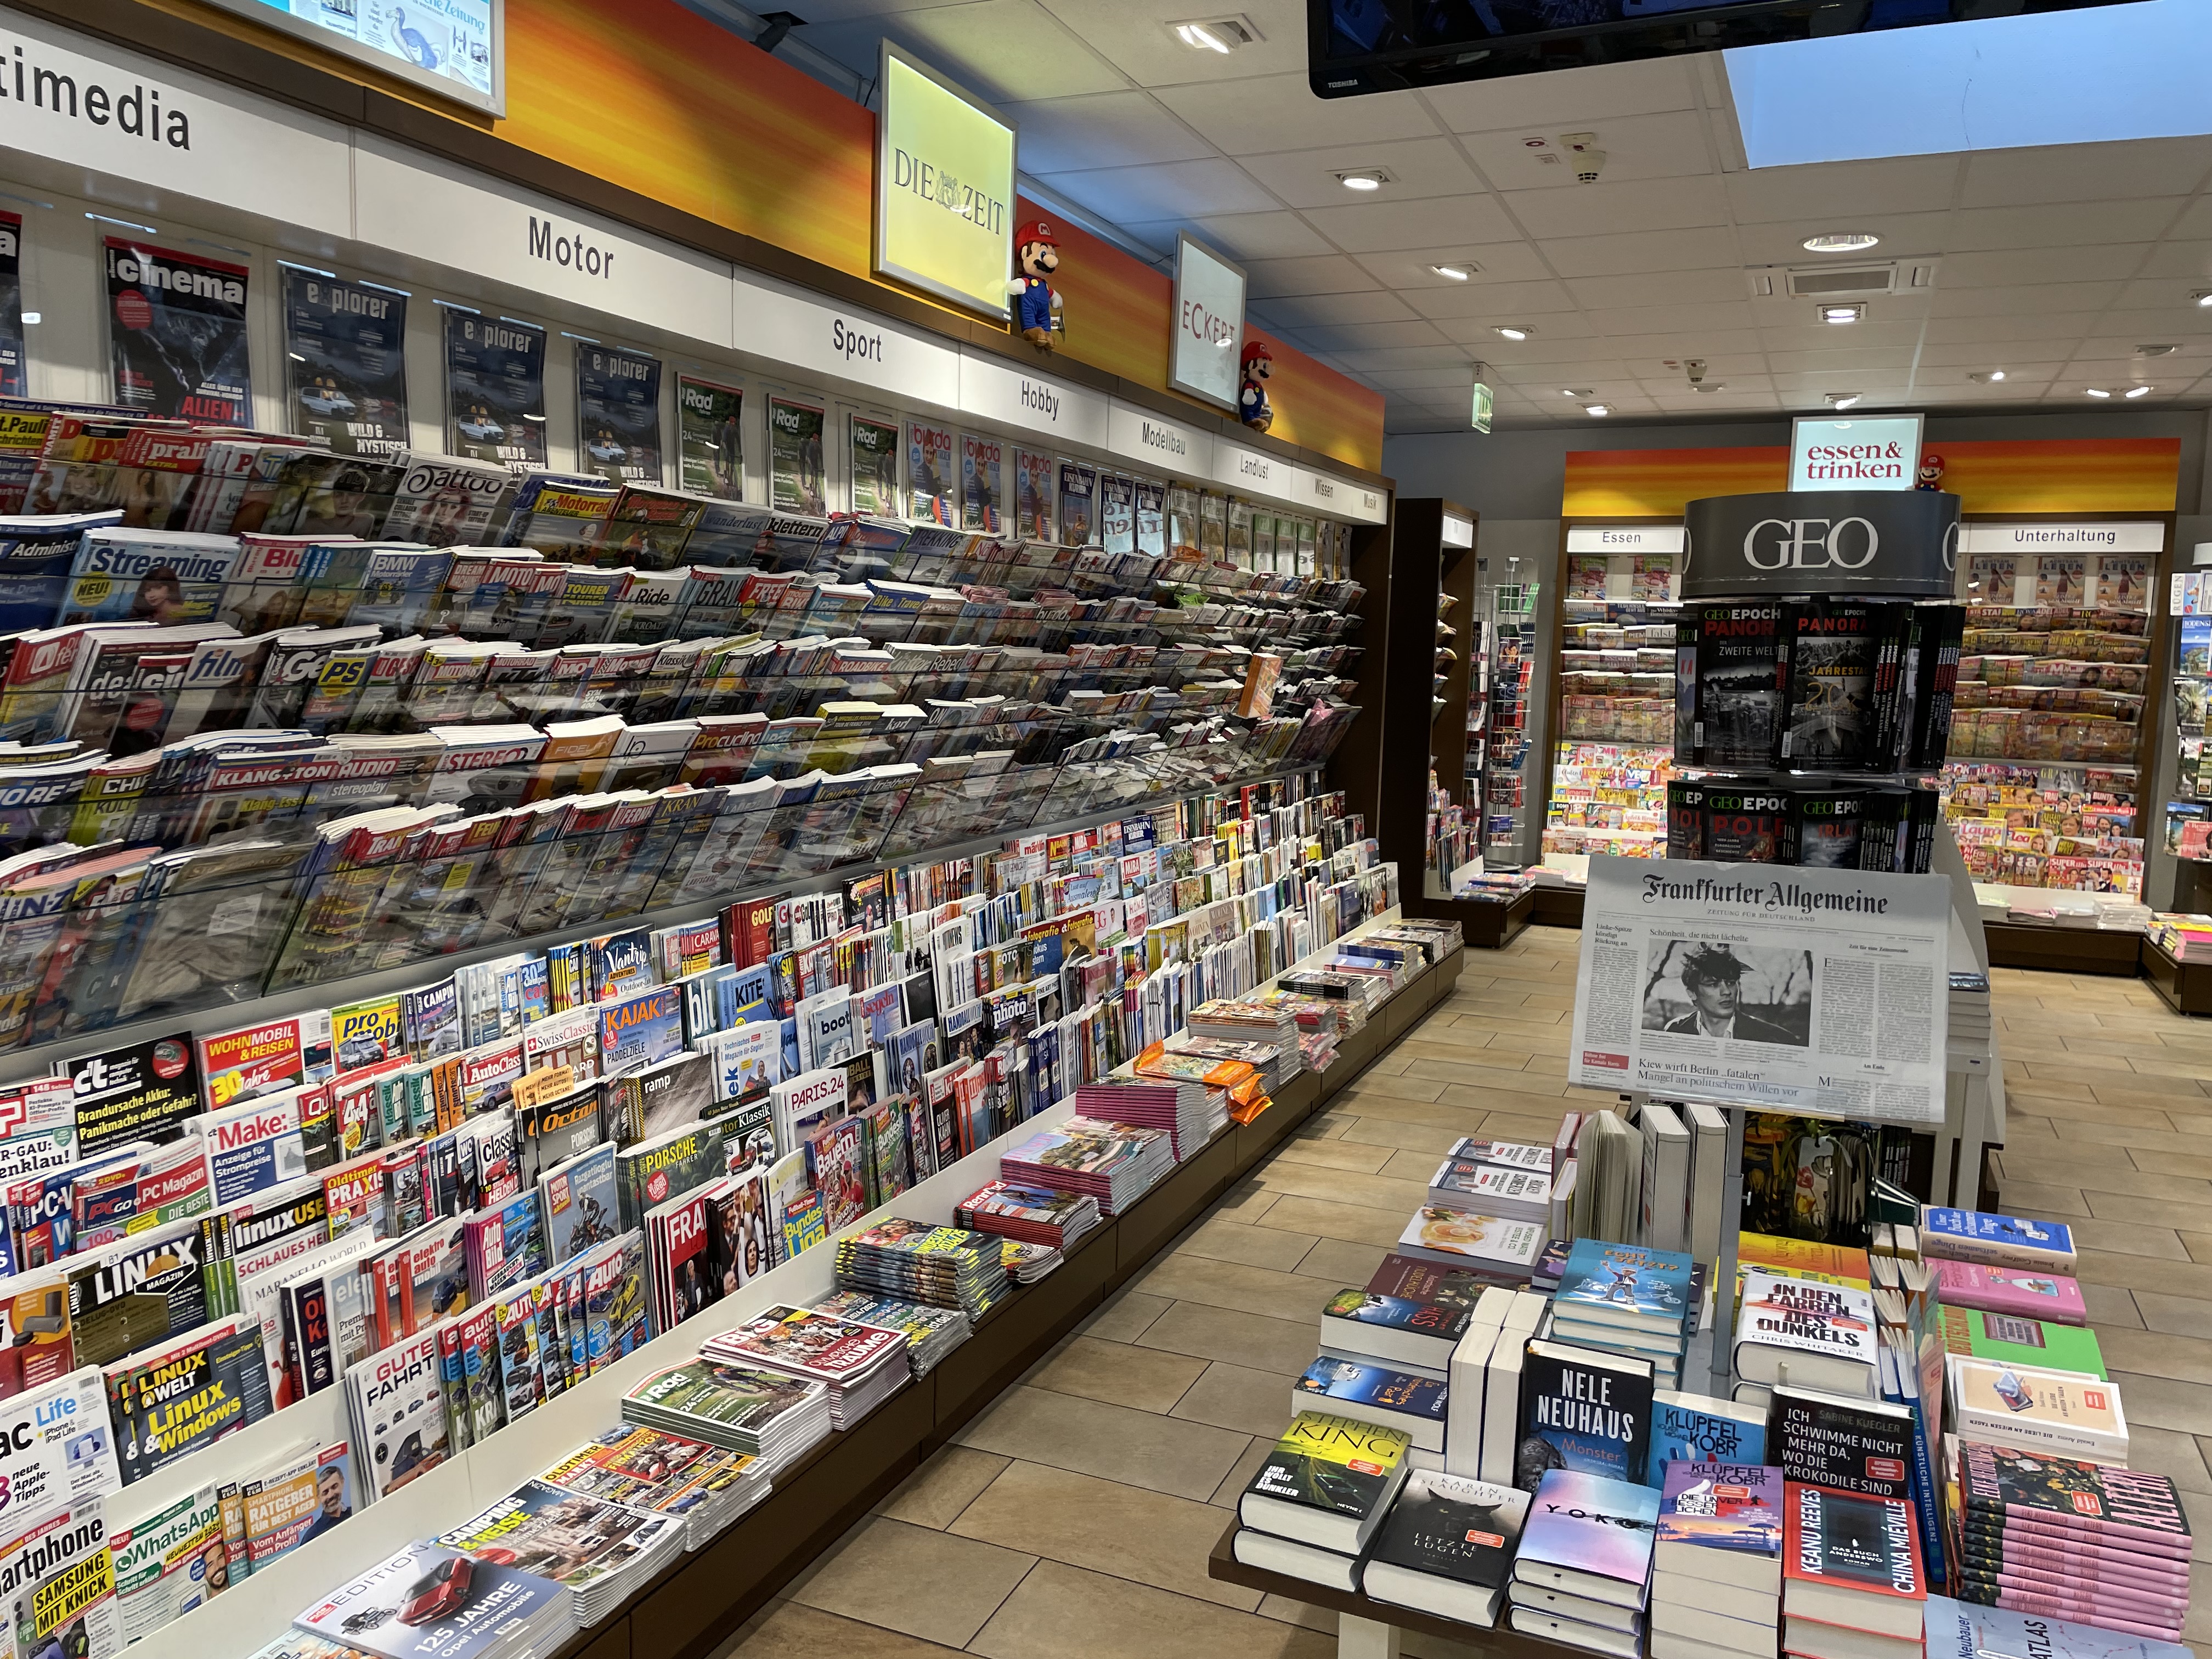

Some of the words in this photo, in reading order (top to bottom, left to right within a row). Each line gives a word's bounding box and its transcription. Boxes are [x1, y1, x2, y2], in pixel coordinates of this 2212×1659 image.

[1328, 79, 1358, 88] TOSHIBA
[894, 148, 935, 202] DIE
[960, 184, 1004, 236] ZEIT
[529, 216, 614, 279] Motor
[116, 258, 246, 306] cinema
[1182, 299, 1236, 353] ECKERT
[833, 319, 882, 362] Sport
[1021, 380, 1060, 421] Hobby
[1142, 421, 1186, 456] Modellbau
[1807, 442, 1882, 461] essen
[1885, 441, 1904, 459] &
[407, 463, 505, 495] Tattoo
[1240, 454, 1268, 481] Landlust
[1807, 461, 1903, 479] trinken
[1315, 478, 1333, 499] Wissen
[557, 493, 608, 513] Motorrad
[1602, 531, 1641, 544] Essen
[1743, 517, 1878, 571] GEO
[2015, 529, 2116, 544] Unterhaltung
[91, 547, 231, 583] Streaming
[375, 555, 420, 572] BMW
[77, 579, 110, 597] NEU!
[566, 583, 609, 595] TOUREN
[635, 587, 670, 607] Ride
[2172, 574, 2184, 612] RÜGEN
[1705, 609, 1730, 620] GEO
[495, 657, 535, 667] MOTORRAD
[1719, 645, 1752, 656] ZWEITE
[839, 660, 887, 673] ROADBIKE
[339, 758, 399, 777] AUDIO
[331, 781, 388, 797] stereoplay
[1709, 795, 1742, 810] GEO
[1804, 801, 1833, 815] GEO
[1074, 833, 1088, 852] MIBA
[1124, 857, 1141, 879] MIBA
[1642, 873, 1764, 906] Frankfurter
[1764, 881, 1889, 915] Allgemeine
[1066, 914, 1094, 932] Fotografie
[1707, 909, 1740, 917] ZEITUNG
[1759, 913, 1816, 922] DEUTSCHLAND
[1027, 926, 1059, 943] Fotografie
[605, 941, 647, 973] Vantrip
[735, 978, 764, 1008] KITE
[343, 1011, 379, 1038] pro
[606, 997, 661, 1032] KAJAK
[821, 1011, 850, 1035] boot
[992, 1001, 1027, 1030] photo
[209, 1025, 295, 1057] WOHNMOBIL
[251, 1038, 294, 1058] REISEN
[607, 1042, 646, 1064] PADDELZIELE
[1639, 1058, 1661, 1069] Kiew
[1690, 1065, 1718, 1075] Berlin
[644, 1073, 672, 1094] ramp
[791, 1073, 845, 1110] PARIS.24
[1638, 1070, 1673, 1083] Mangel
[1690, 1077, 1745, 1091] politischem
[1748, 1082, 1779, 1094] Willen
[77, 1094, 144, 1125] Brandursache
[145, 1087, 171, 1107] Akku:
[80, 1110, 138, 1141] Panikmache
[139, 1105, 161, 1122] oder
[162, 1093, 198, 1116] Gefahr?
[219, 1112, 291, 1150] Make:
[214, 1149, 251, 1169] Anzeige
[215, 1153, 272, 1178] Strompreise
[645, 1137, 697, 1174] PORSCHE
[162, 1166, 205, 1197] Magazin
[327, 1163, 379, 1189] Oldtimer
[94, 1233, 200, 1304] LINUX
[238, 1242, 306, 1279] SCHLAUES
[145, 1269, 184, 1292] MAGAZIN
[1774, 1283, 1796, 1297] IN
[1801, 1289, 1842, 1305] DEN
[1768, 1293, 1850, 1318] FARBEN
[1752, 1333, 1791, 1345] CHRIS
[1794, 1340, 1865, 1357] WHITAKER
[1756, 1318, 1860, 1348] DUNKELS
[139, 1351, 207, 1392] LINUX
[376, 1338, 435, 1382] GUTE
[155, 1369, 198, 1402] WELT
[366, 1353, 435, 1407] FAHRT
[1561, 1368, 1612, 1407] NELE
[35, 1396, 77, 1427] Life
[148, 1379, 227, 1435] Linux
[1537, 1395, 1634, 1442] NEUHAUS
[1787, 1408, 1810, 1423] ICH
[1819, 1410, 1854, 1425] SABINE
[157, 1396, 242, 1454] Windows
[1300, 1412, 1406, 1443] STEPHEN
[1664, 1408, 1743, 1442] KLÜPFEL
[1783, 1421, 1859, 1447] SCHWIMME
[1862, 1437, 1904, 1455] NICHT
[1291, 1421, 1397, 1458] KING
[1561, 1437, 1622, 1463] Monster
[1689, 1431, 1737, 1458] KOBR
[1787, 1436, 1826, 1454] MEHR
[1829, 1445, 1851, 1461] DA,
[12, 1462, 41, 1479] neue
[545, 1444, 602, 1481] OLDTIMER
[557, 1457, 596, 1485] MARKT
[1267, 1465, 1286, 1474] IHR
[1691, 1463, 1771, 1479] KLÜPFEL
[1782, 1449, 1804, 1465] WO
[1807, 1454, 1828, 1470] DIE
[13, 1470, 51, 1493] Apple-
[528, 1480, 566, 1498] MAGAZIN
[1255, 1482, 1299, 1497] DUNKLER
[1263, 1471, 1294, 1482] WOLLT
[1442, 1478, 1498, 1494] KARIN
[1716, 1473, 1767, 1487] KOBR
[1784, 1465, 1858, 1491] KROKODILE
[1860, 1480, 1893, 1496] SIND
[14, 1483, 46, 1504] Tipps
[250, 1483, 314, 1522] RATGEBER
[271, 1511, 293, 1527] BEST
[295, 1500, 315, 1517] AGER
[438, 1497, 527, 1547] CAMPING
[1801, 1489, 1821, 1528] REEVES
[126, 1503, 219, 1566] WhatsApp
[253, 1536, 274, 1549] Vom
[275, 1519, 313, 1543] Anfänger
[475, 1510, 532, 1543] REISE
[254, 1547, 274, 1560] zum
[1415, 1533, 1479, 1551] LETZTE
[1801, 1527, 1822, 1575] KEANU
[1832, 1545, 1852, 1554] DAS
[1856, 1549, 1880, 1558] BUCH
[36, 1553, 104, 1611] SAMSUNG
[331, 1544, 430, 1606] EDITION
[1891, 1552, 1916, 1593] CHINA
[38, 1606, 61, 1634] MIT
[66, 1576, 108, 1616] KNICK
[414, 1627, 455, 1655] 125
[453, 1581, 523, 1624] JAHRE
[441, 1634, 473, 1658] Opel
[472, 1590, 535, 1636] Automobile
